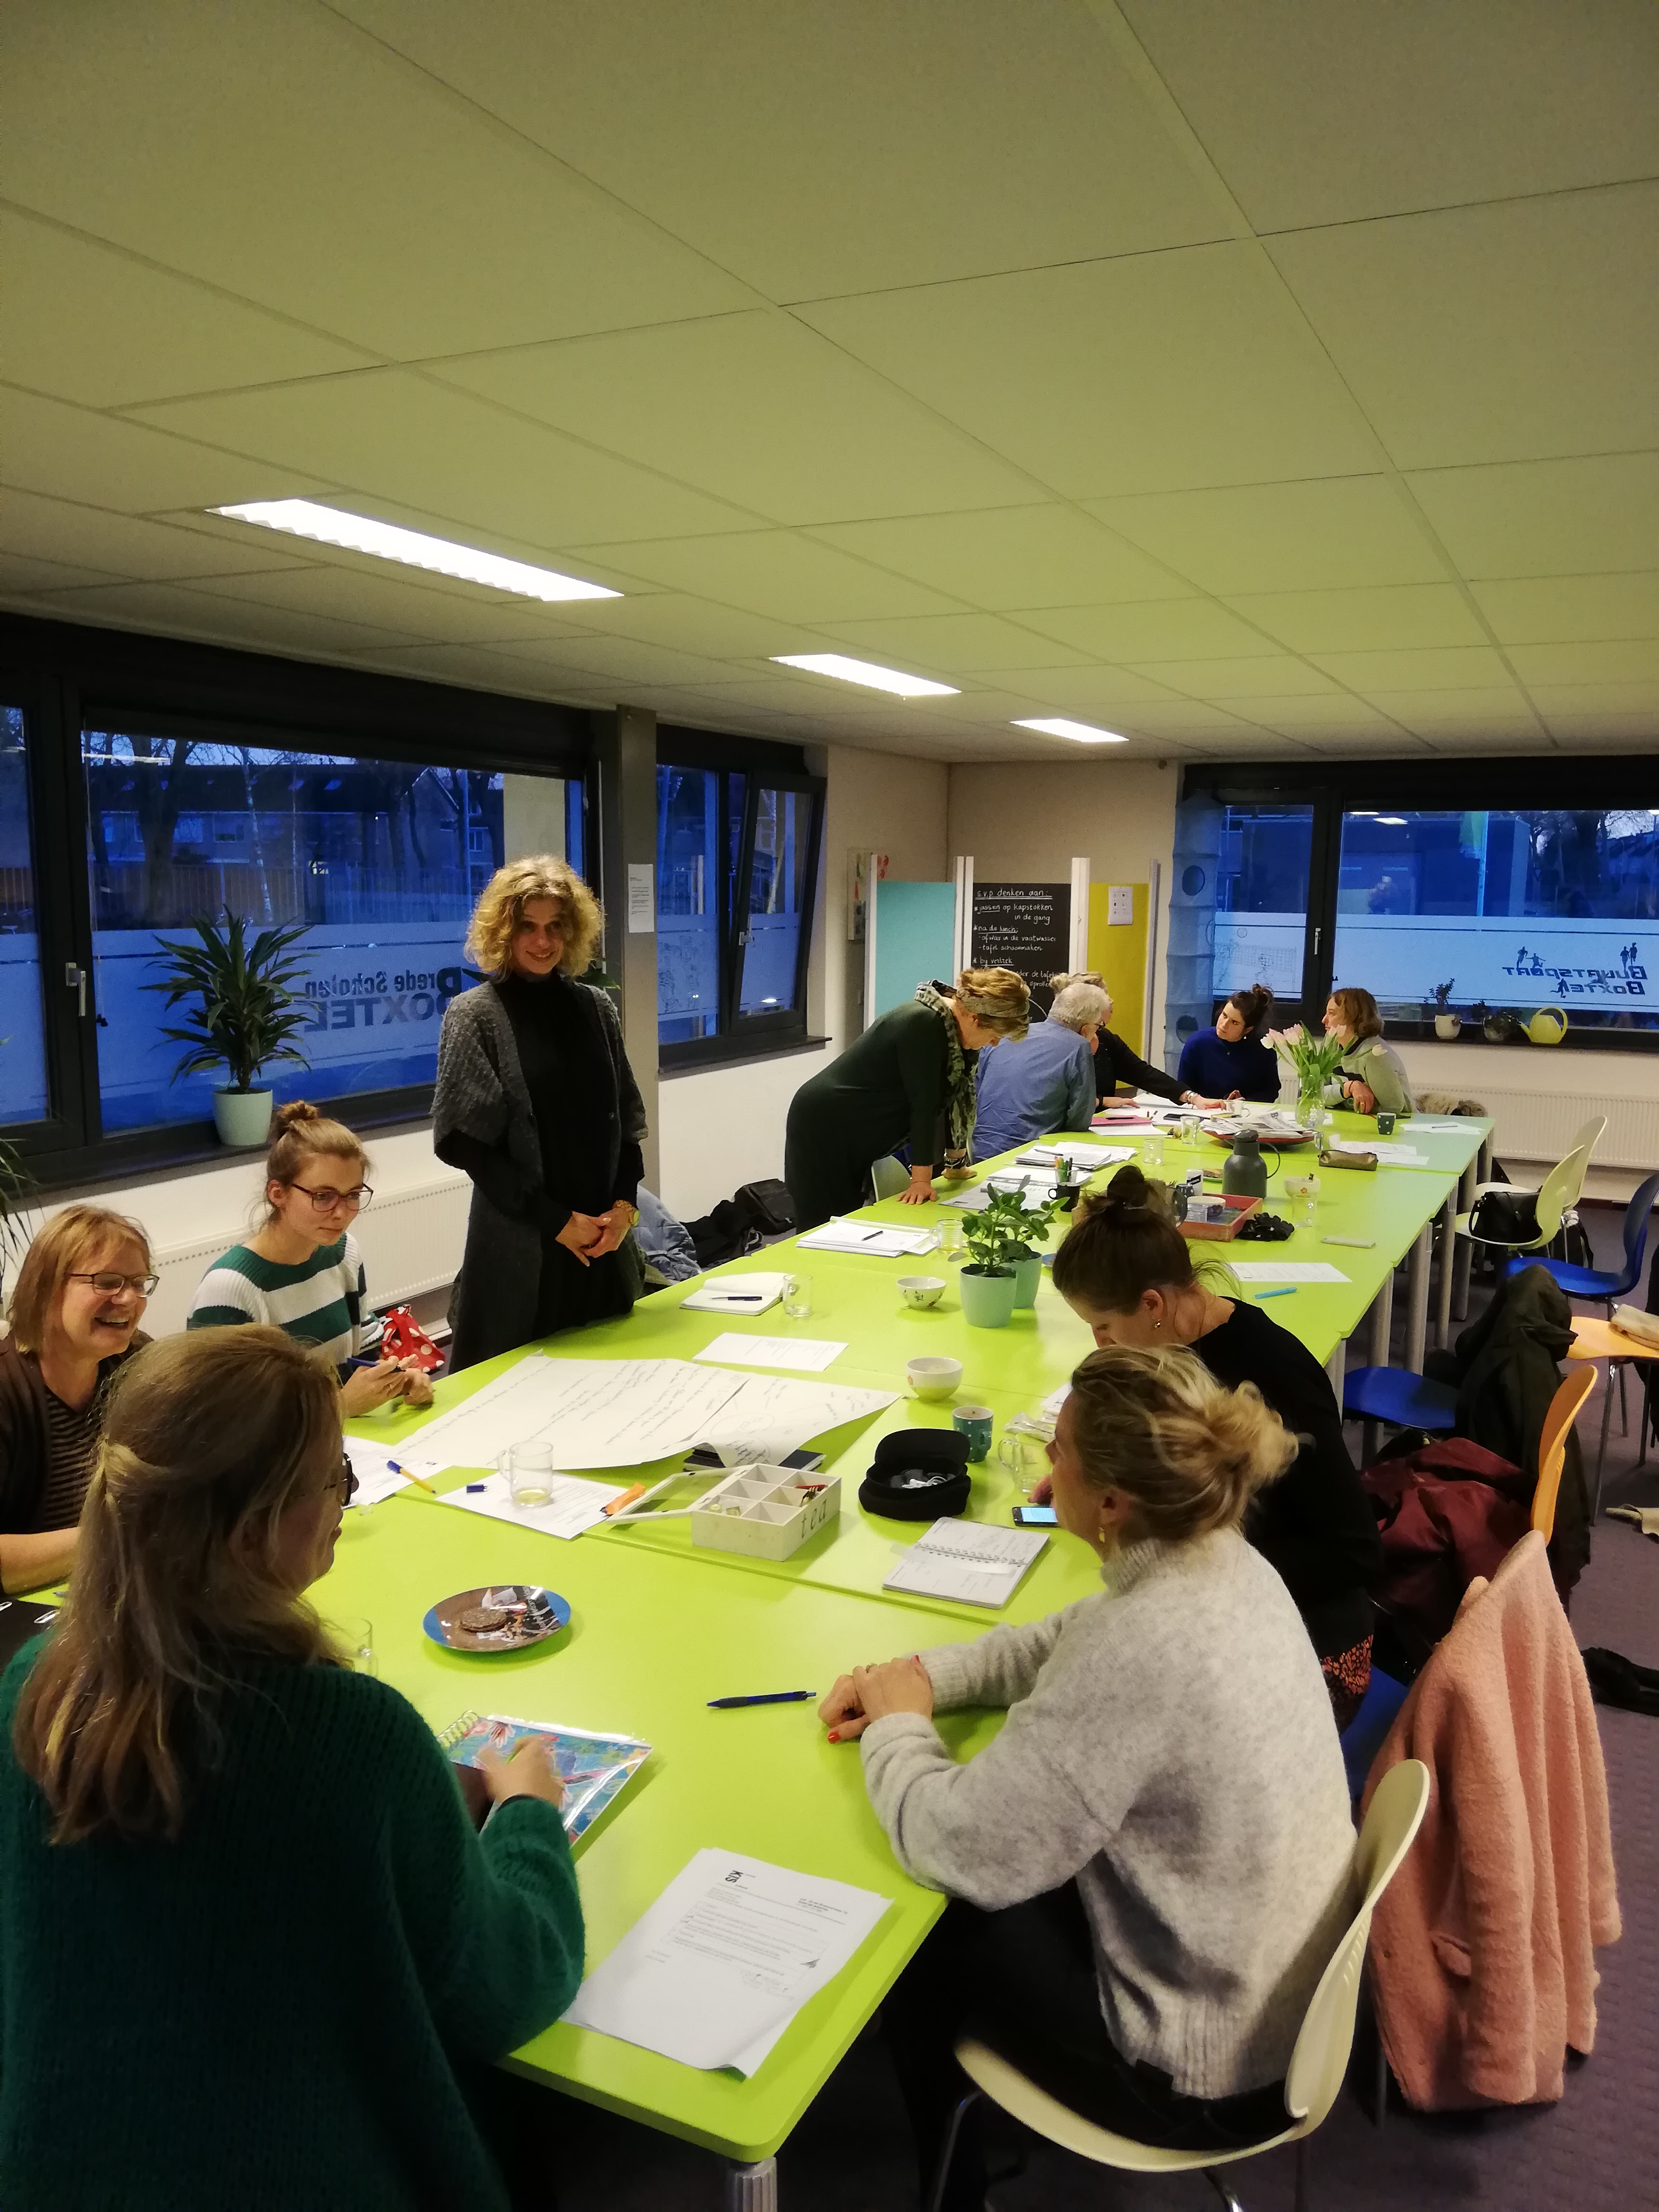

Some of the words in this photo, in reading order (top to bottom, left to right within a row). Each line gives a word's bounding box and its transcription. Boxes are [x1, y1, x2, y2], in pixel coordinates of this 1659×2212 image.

[997, 888, 1024, 896] denken
[1002, 904, 1011, 913] op
[1013, 903, 1053, 913] kapstokken
[1034, 915, 1050, 926] gang
[801, 1499, 827, 1539] tea
